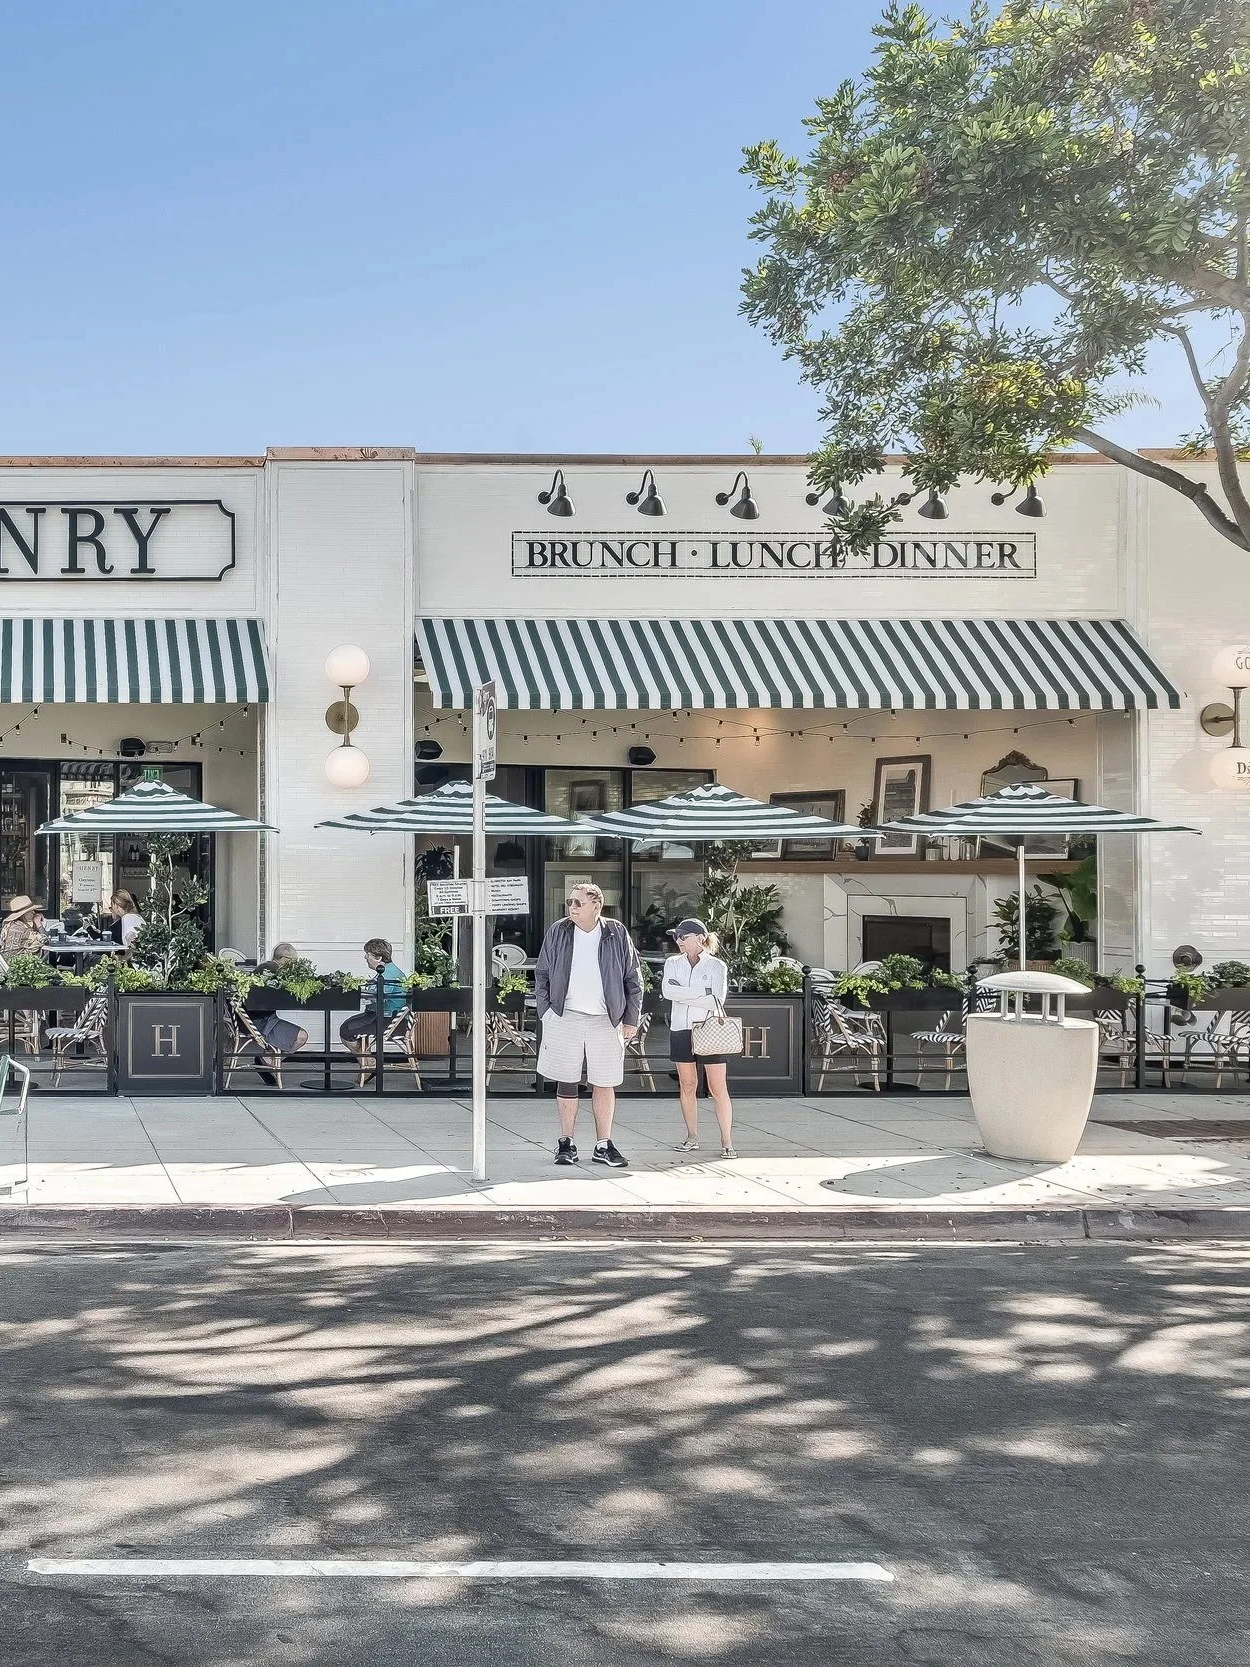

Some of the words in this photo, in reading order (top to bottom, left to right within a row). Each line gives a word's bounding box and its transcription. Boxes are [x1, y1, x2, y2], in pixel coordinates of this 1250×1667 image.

[525, 541, 679, 568] BRUNCH
[708, 541, 841, 569] LUNCH
[870, 541, 1022, 569] DINNER
[440, 906, 461, 915] FREE
[151, 1024, 181, 1057] H
[741, 1026, 771, 1059] H
